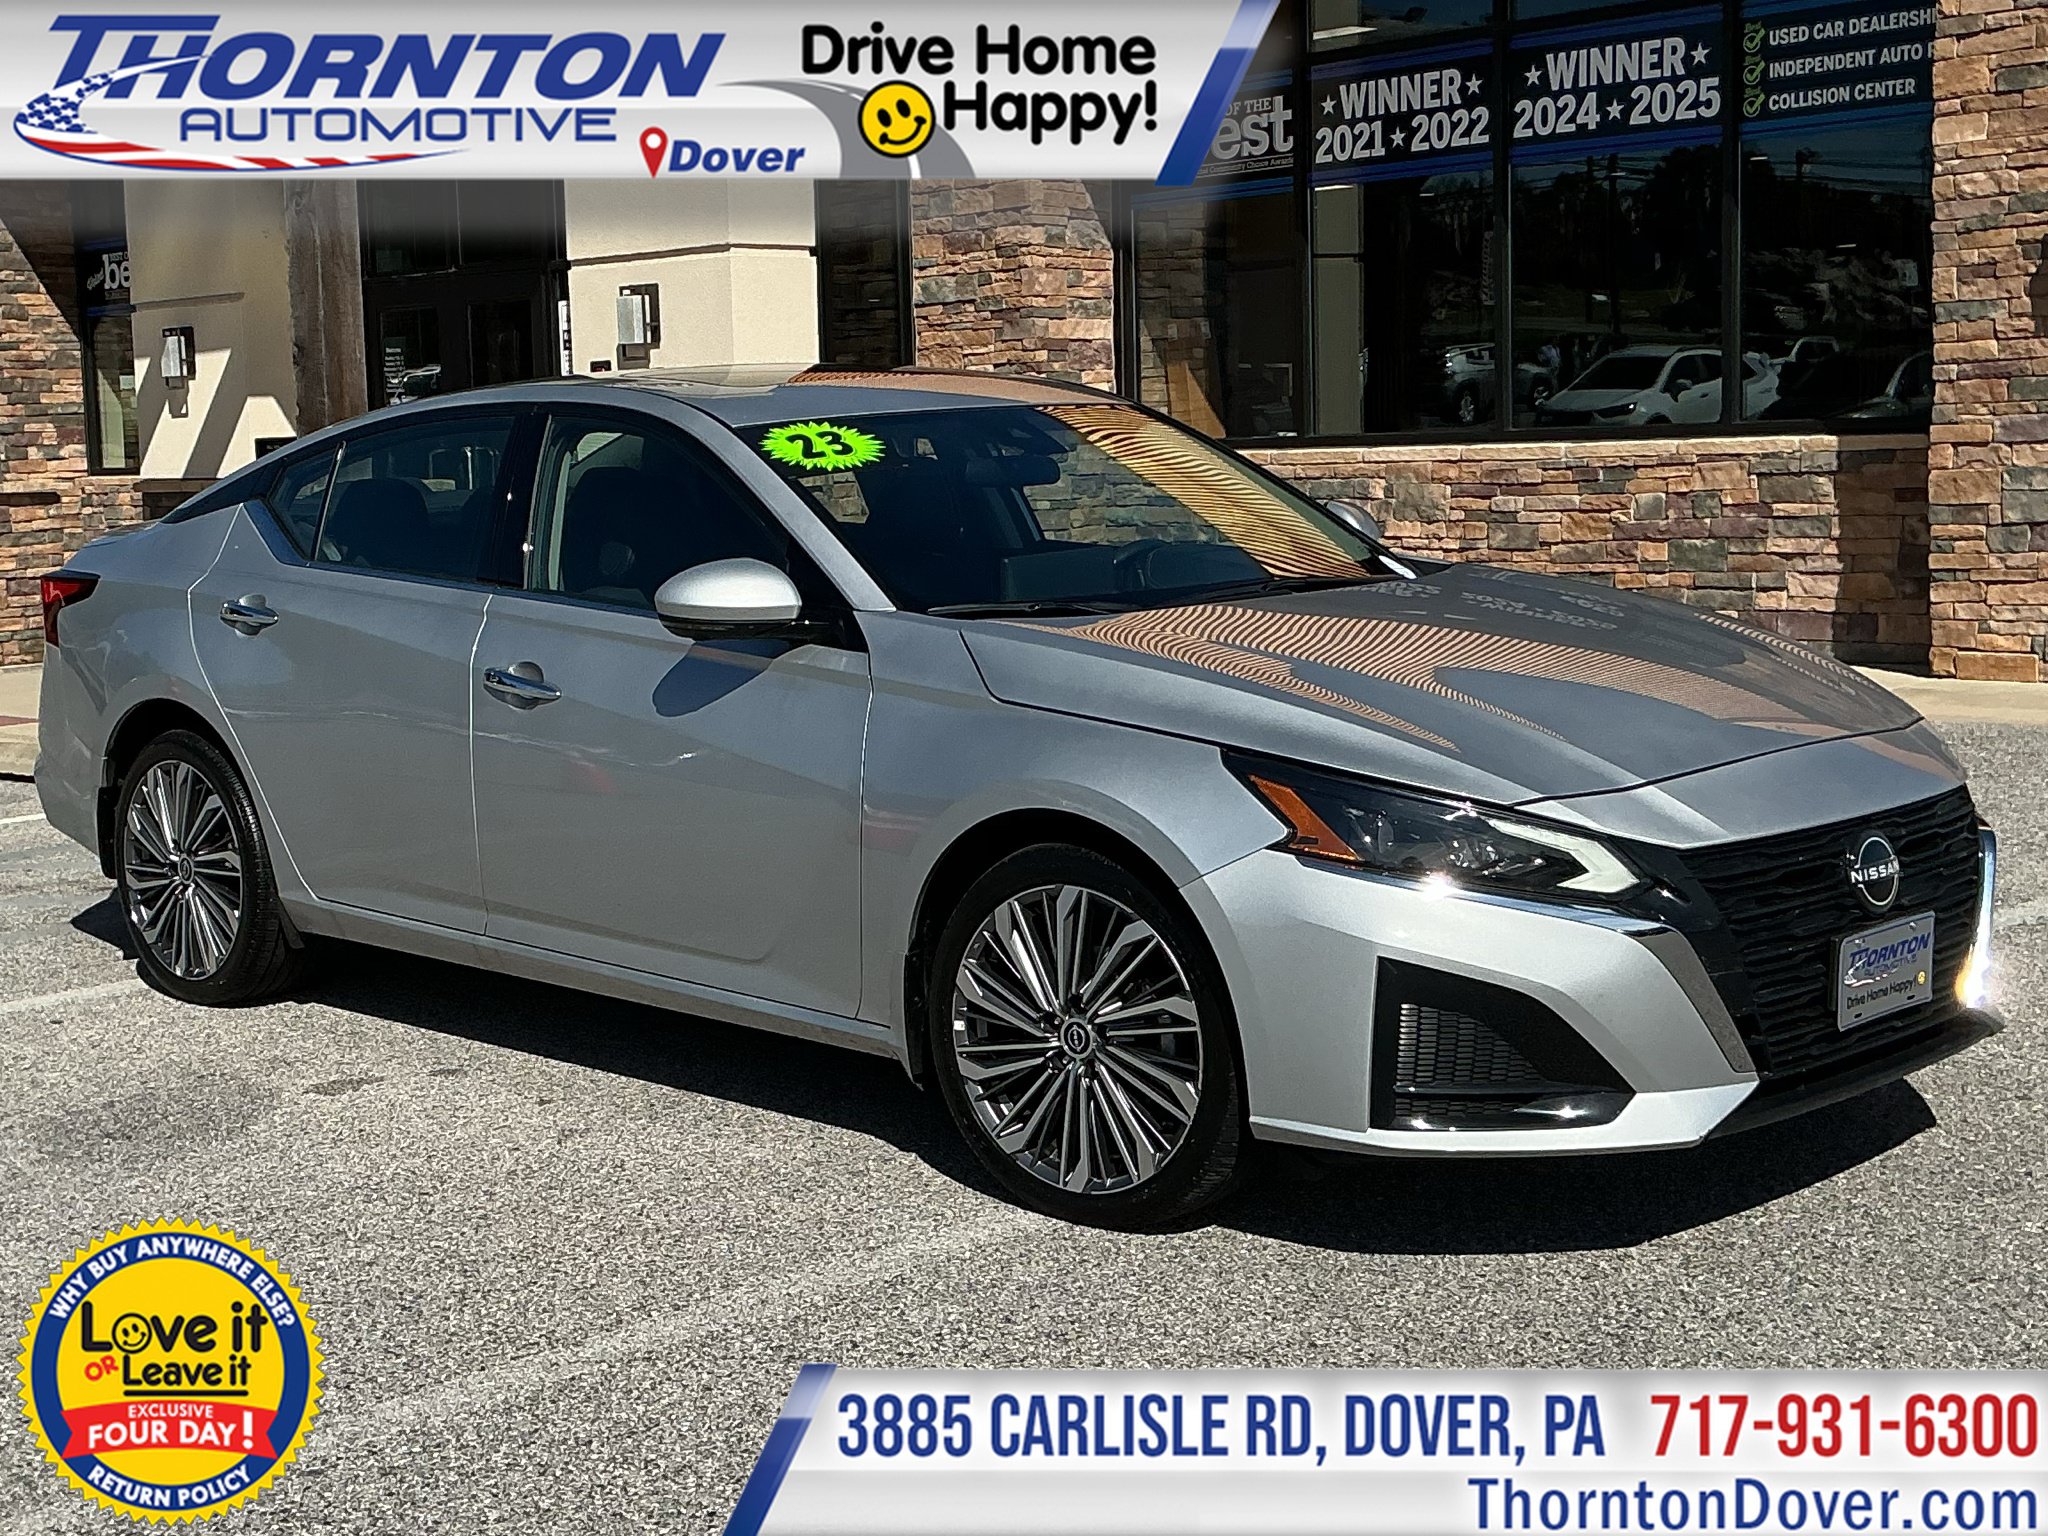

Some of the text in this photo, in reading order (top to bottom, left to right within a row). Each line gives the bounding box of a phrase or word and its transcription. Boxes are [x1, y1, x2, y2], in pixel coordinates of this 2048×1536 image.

[1769, 8, 1937, 46] USED CAR DEALERSHI
[1546, 37, 1686, 91] WINNER
[1769, 50, 1876, 79] INDEPENDENT
[1879, 43, 1924, 64] AUTO
[1244, 98, 1272, 113] THE
[1339, 69, 1462, 120] WINNER
[1513, 77, 1721, 139] 2024 2025
[1768, 85, 1850, 111] COLLISION
[1853, 78, 1916, 101] CENTER
[1211, 95, 1294, 160] est
[1315, 106, 1490, 164] 2021 2022
[102, 254, 131, 290] be
[785, 430, 853, 459] 23
[1851, 858, 1899, 884] NISSAN
[1850, 932, 1931, 970] THORNTON
[1847, 994, 1866, 1010] Drive
